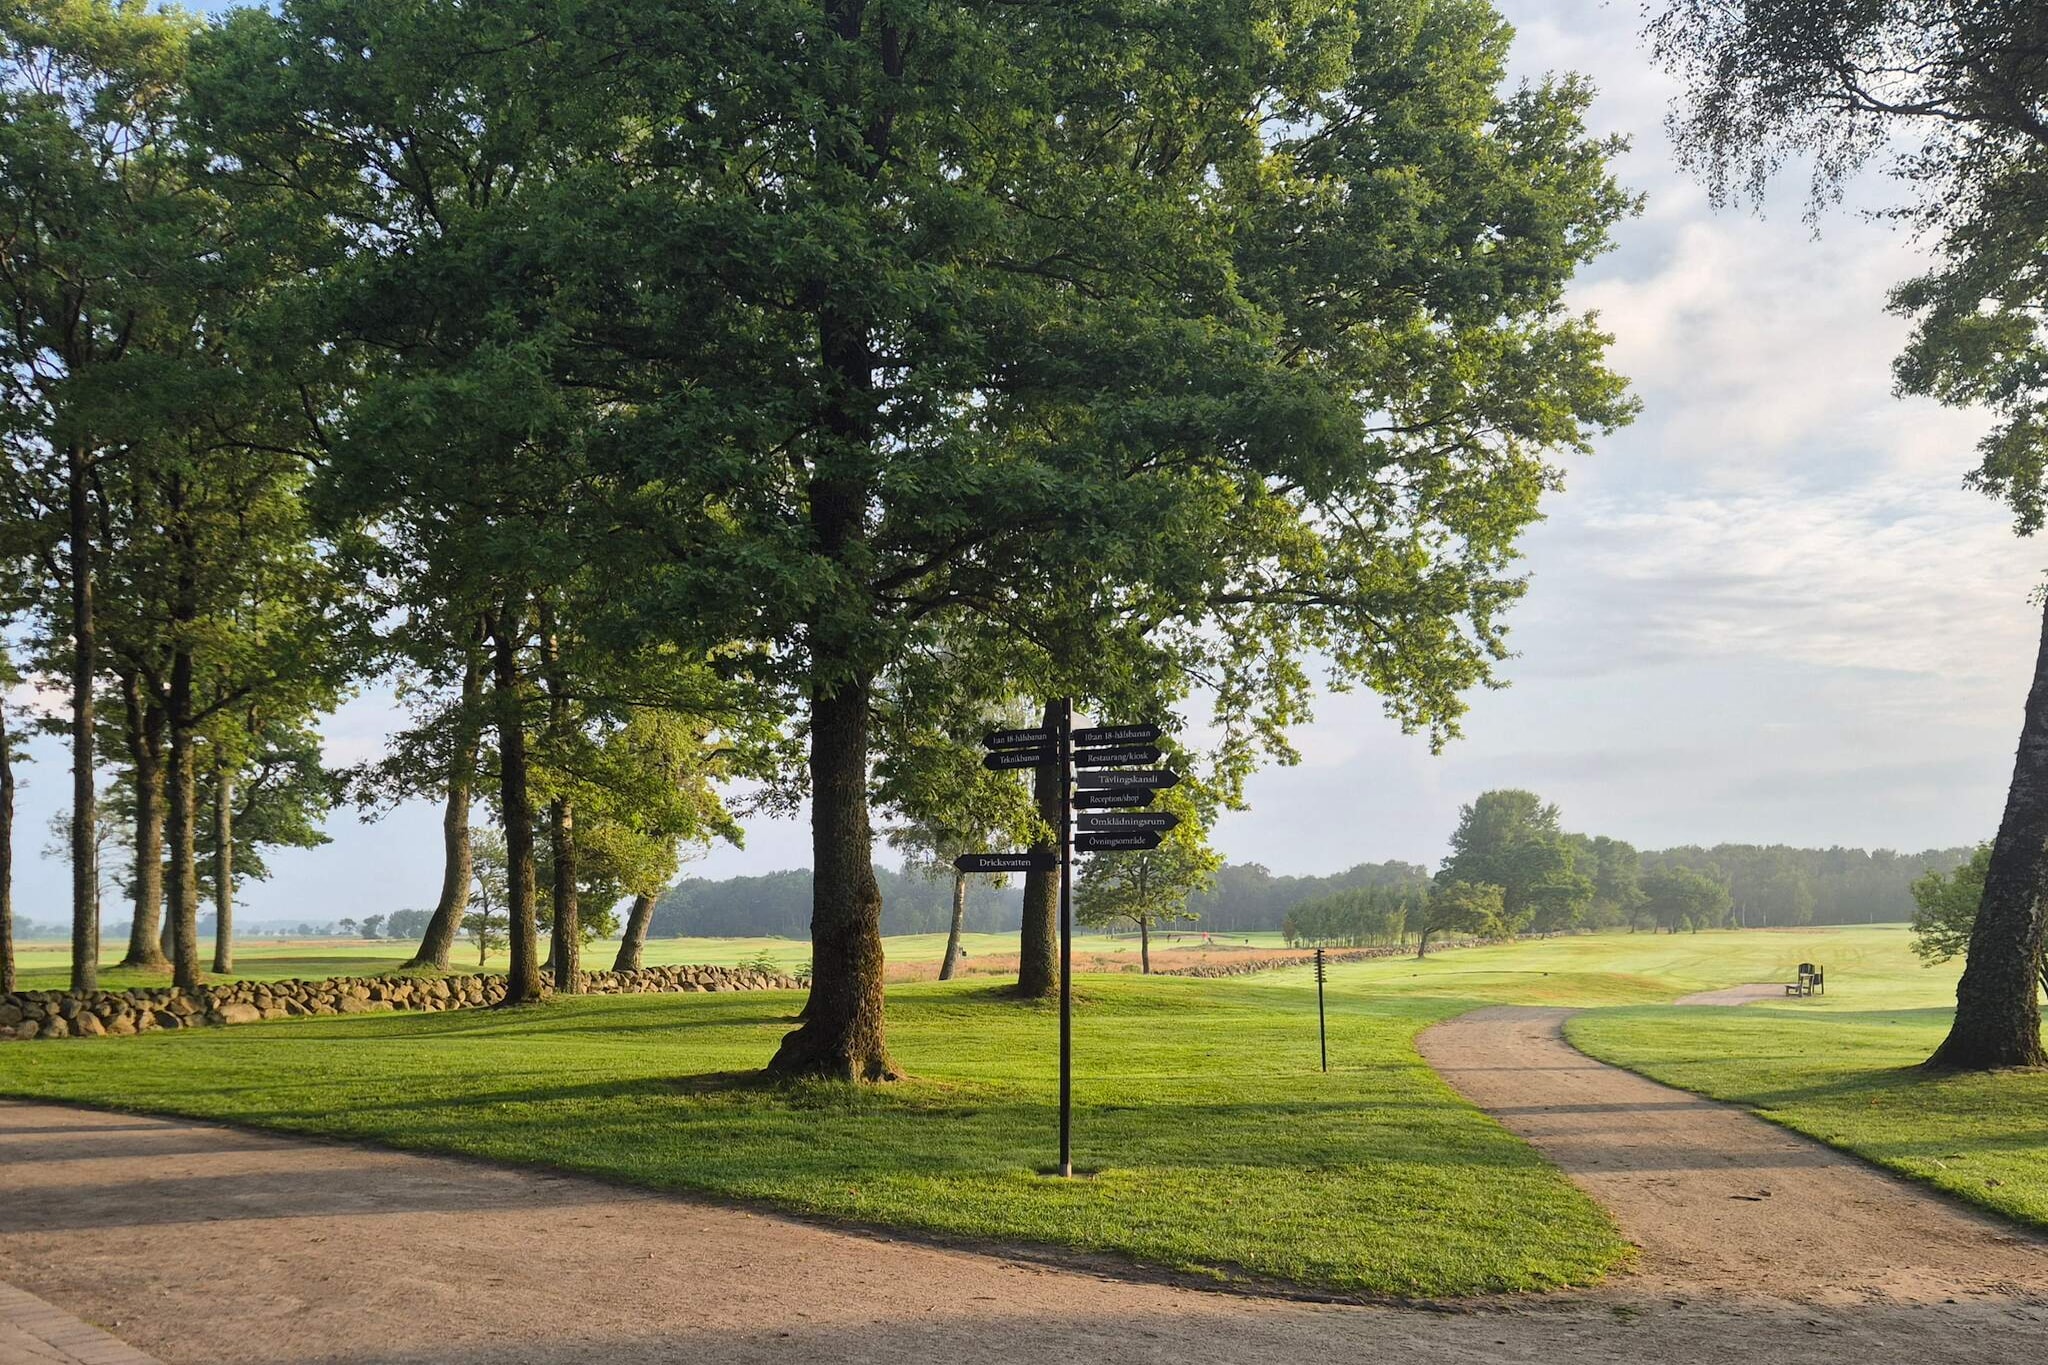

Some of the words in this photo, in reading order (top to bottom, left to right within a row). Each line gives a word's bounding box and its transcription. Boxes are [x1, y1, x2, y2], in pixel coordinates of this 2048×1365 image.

[1105, 730, 1151, 740] 18-hålsbanan
[1000, 754, 1040, 764] Teknikbanan
[1087, 752, 1149, 762] Restaurang/kiosk
[1098, 775, 1158, 785] Tävlingskansli
[1090, 794, 1139, 804] Reception/shop
[1090, 817, 1165, 827] Omklädningsrum
[1089, 836, 1146, 847] Övningsområde
[979, 858, 1032, 867] Dricksvatten
